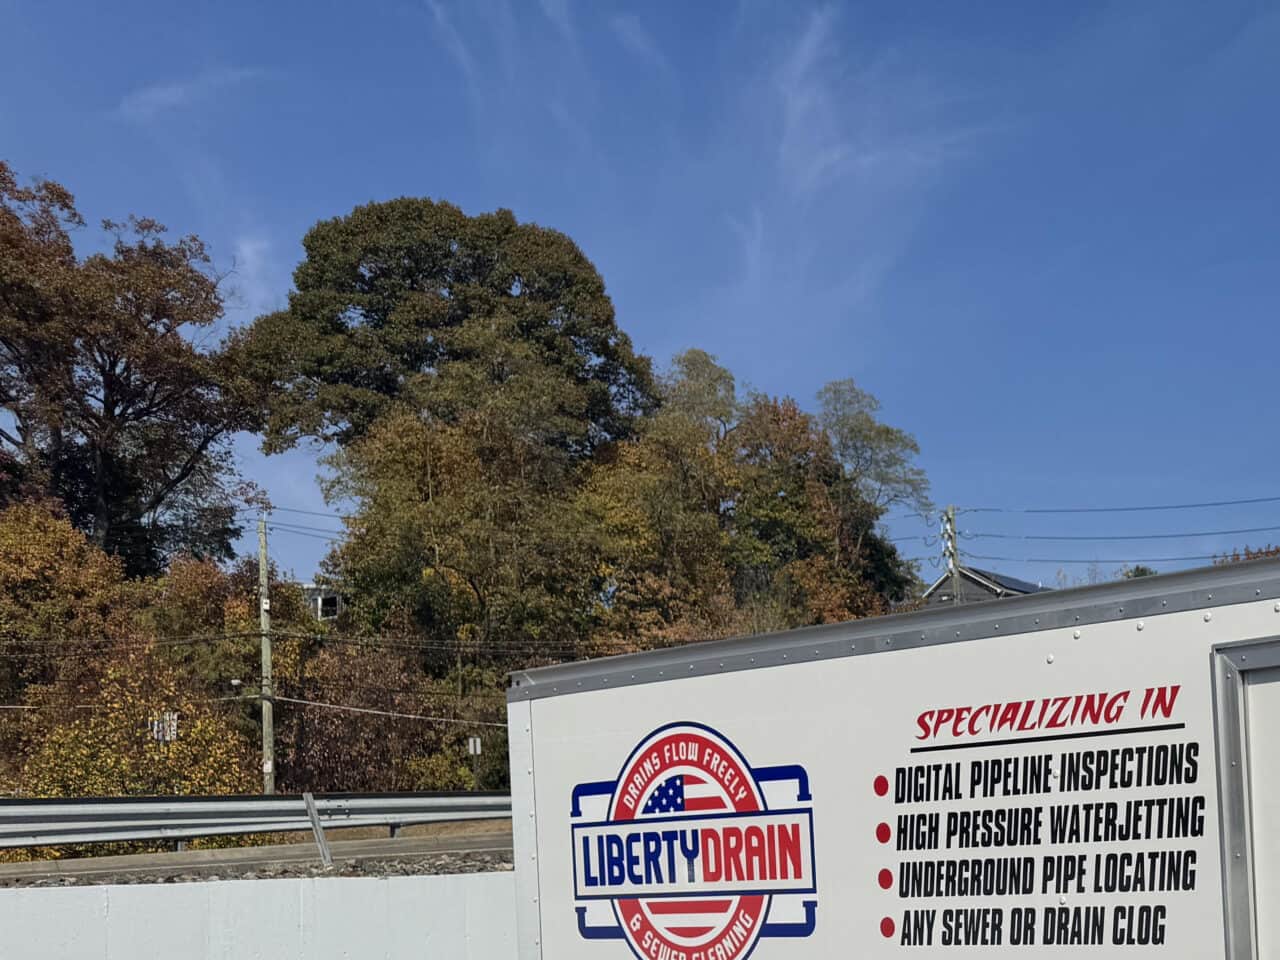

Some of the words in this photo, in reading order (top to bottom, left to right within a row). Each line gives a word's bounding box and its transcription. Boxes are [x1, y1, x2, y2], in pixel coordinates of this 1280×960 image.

[915, 691, 1131, 740] SPECIALIZING
[1140, 685, 1181, 719] IN
[623, 752, 661, 810] DRAINS
[664, 741, 699, 764] FLOW
[703, 748, 748, 802] FREELY
[894, 762, 963, 804] DIGITAL
[969, 754, 1053, 799] PIPELINE
[1059, 742, 1200, 793] INSPECTIONS
[896, 812, 940, 851] HIGH
[946, 806, 1043, 849] PRESSURE
[1049, 795, 1206, 845] WATERJETTING
[582, 823, 803, 887] LIBERTYDRAIN
[898, 856, 1035, 898] UNDERGROUND
[1041, 854, 1087, 895] PIPE
[1093, 849, 1198, 893] LOCATING
[630, 913, 643, 933] &
[900, 909, 937, 946] ANY
[941, 908, 1004, 946] SEWER
[1009, 907, 1036, 946] OR
[1042, 906, 1106, 946] DRAIN
[1112, 904, 1167, 946] CLOG
